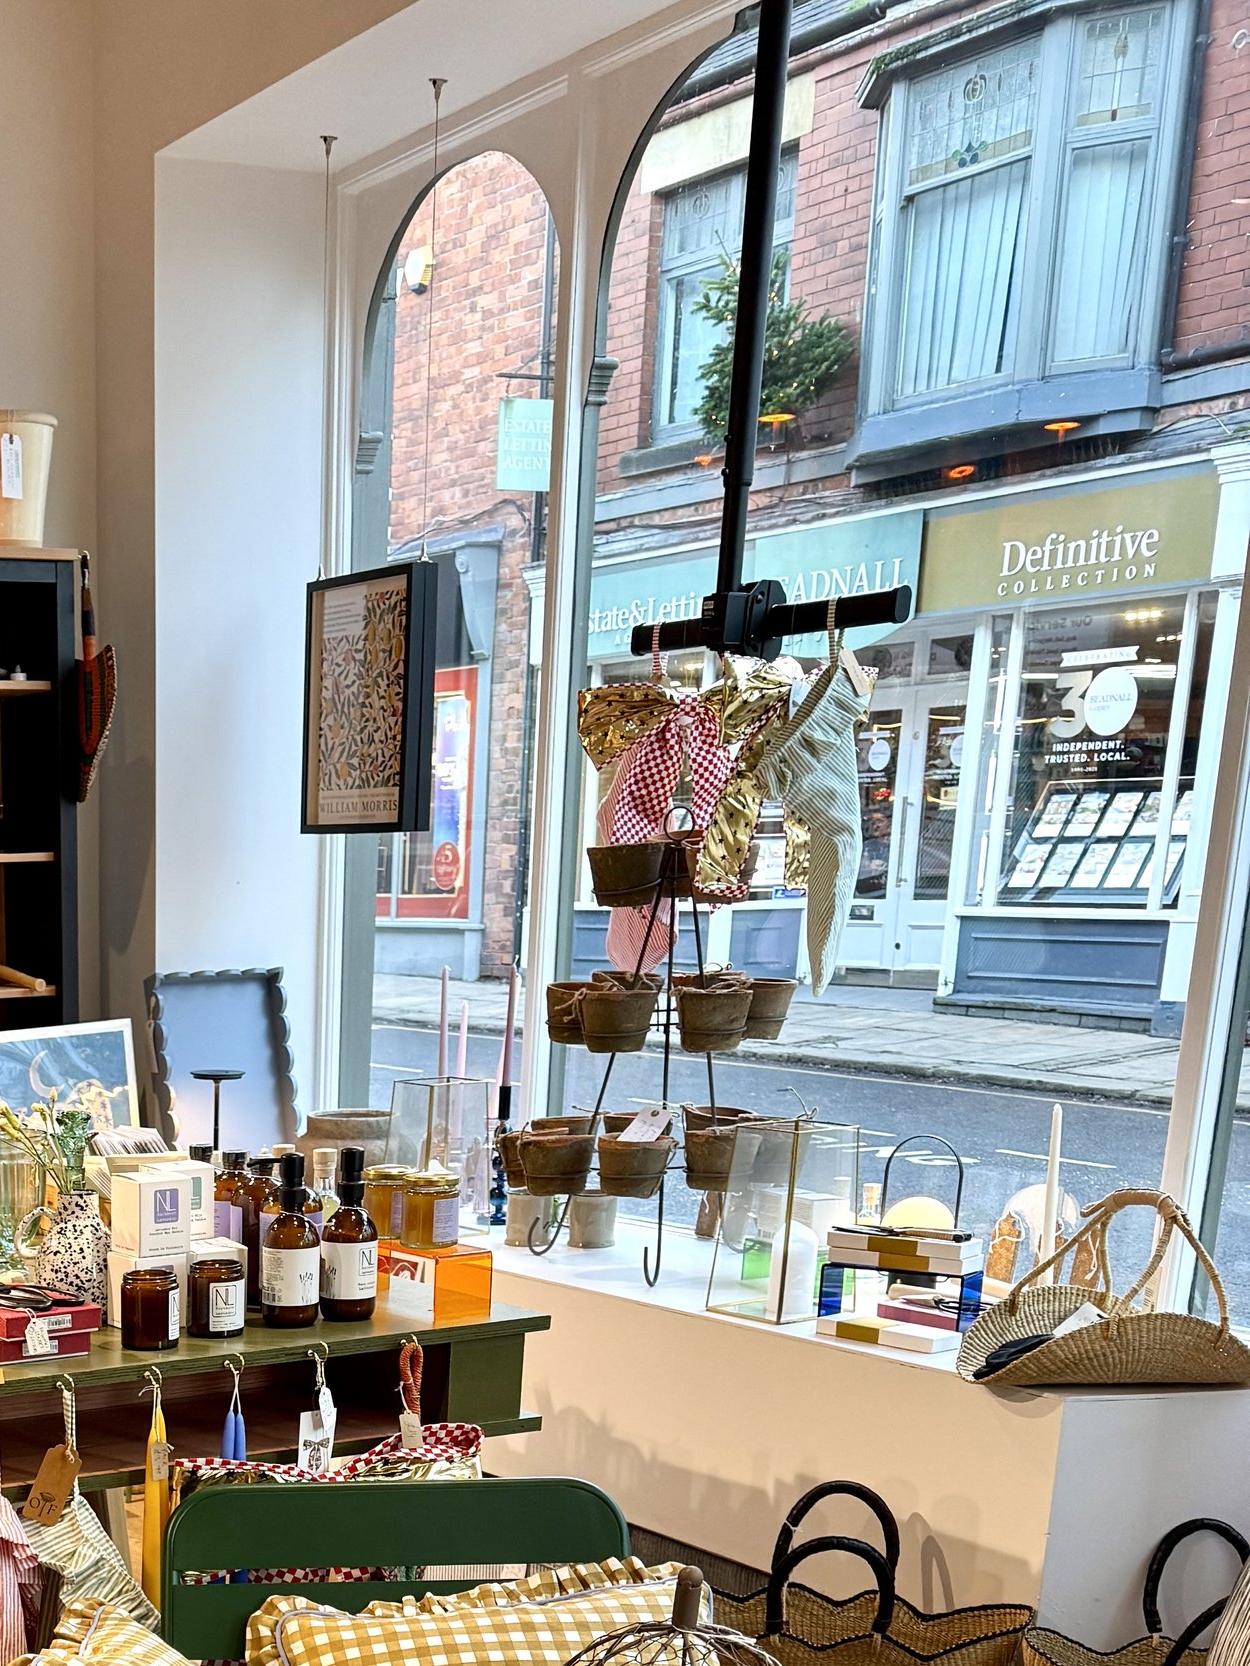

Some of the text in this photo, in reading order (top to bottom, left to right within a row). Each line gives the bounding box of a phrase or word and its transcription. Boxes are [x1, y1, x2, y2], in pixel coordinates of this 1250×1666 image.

[504, 419, 550, 433] ESTATE
[503, 437, 552, 452] LETTIN
[502, 456, 550, 470] AGENT
[999, 525, 1160, 577] Definitive
[776, 558, 909, 604] EADNALL
[997, 563, 1156, 596] COLLECTION
[1067, 650, 1132, 663] CELEBRATING
[1090, 692, 1134, 704] BEADNALL
[1053, 740, 1125, 752] INDEPENDENT.
[1044, 753, 1130, 764] TRUSTED. LOCAL.
[319, 800, 398, 814] WILLIAM MORRIS
